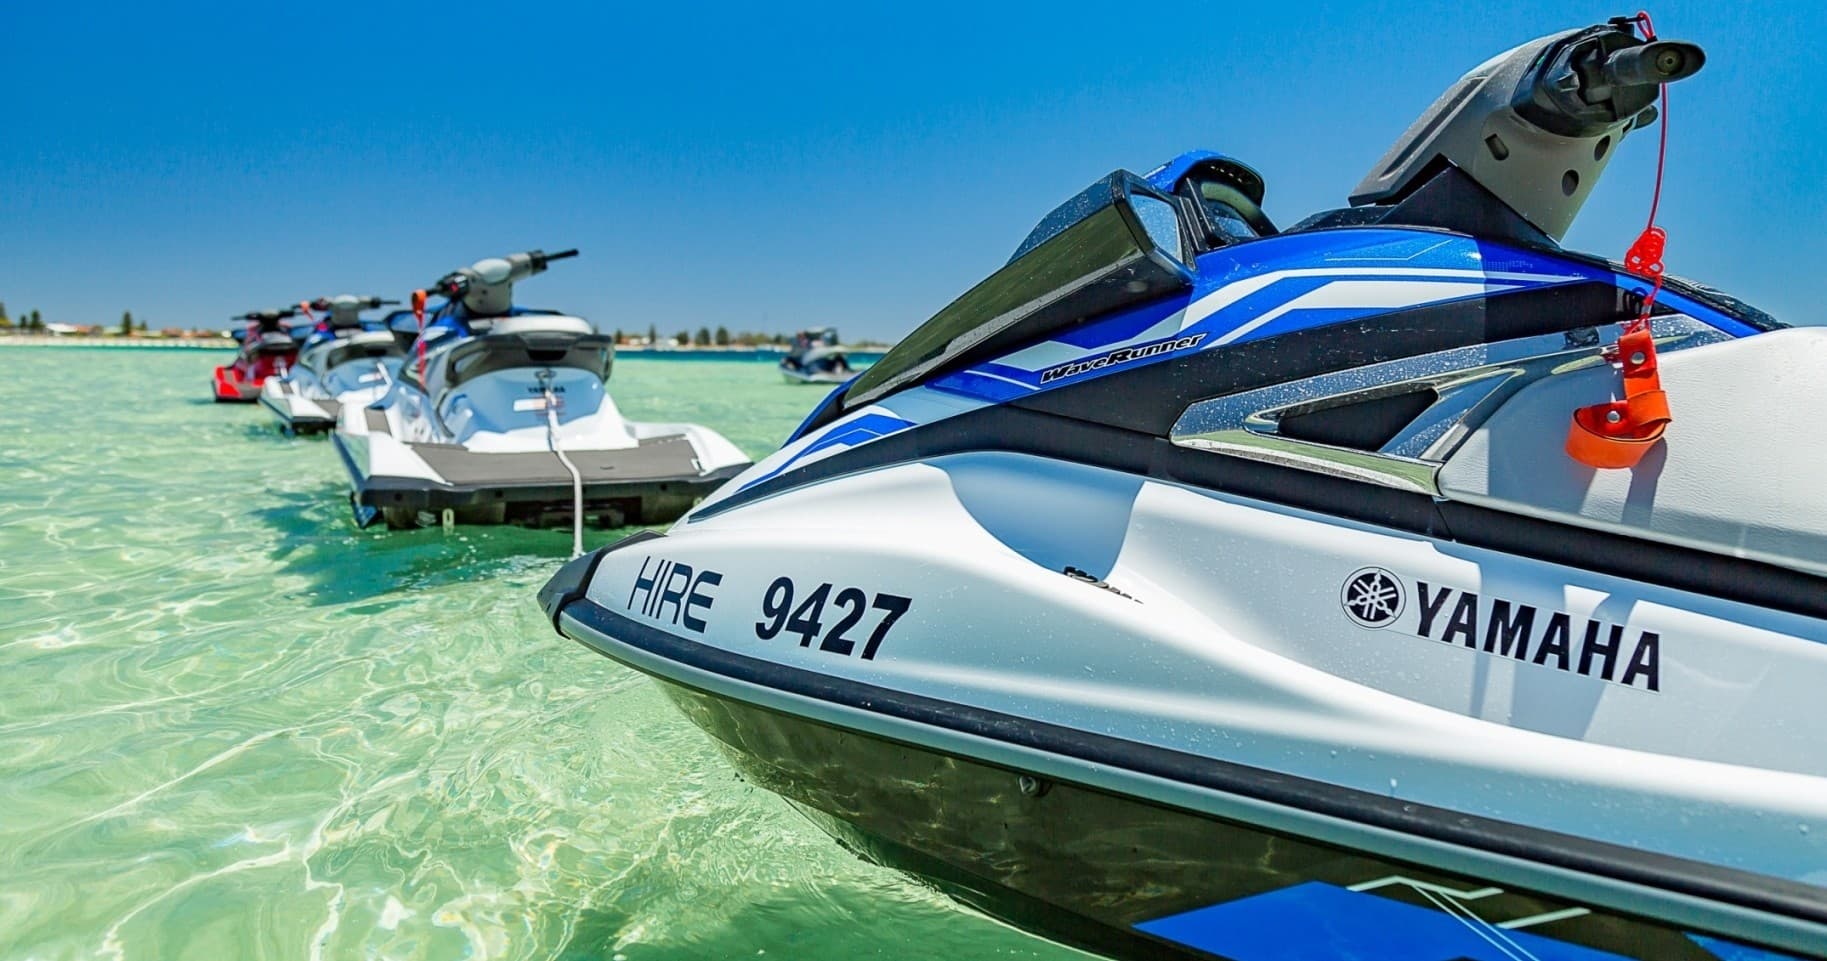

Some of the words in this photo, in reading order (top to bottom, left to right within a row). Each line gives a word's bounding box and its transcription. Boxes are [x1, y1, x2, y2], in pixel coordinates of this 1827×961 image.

[1040, 333, 1207, 384] WaveRunner
[627, 556, 724, 633] HIRE
[755, 576, 913, 661] 9427
[1416, 581, 1660, 692] YAMAHA
